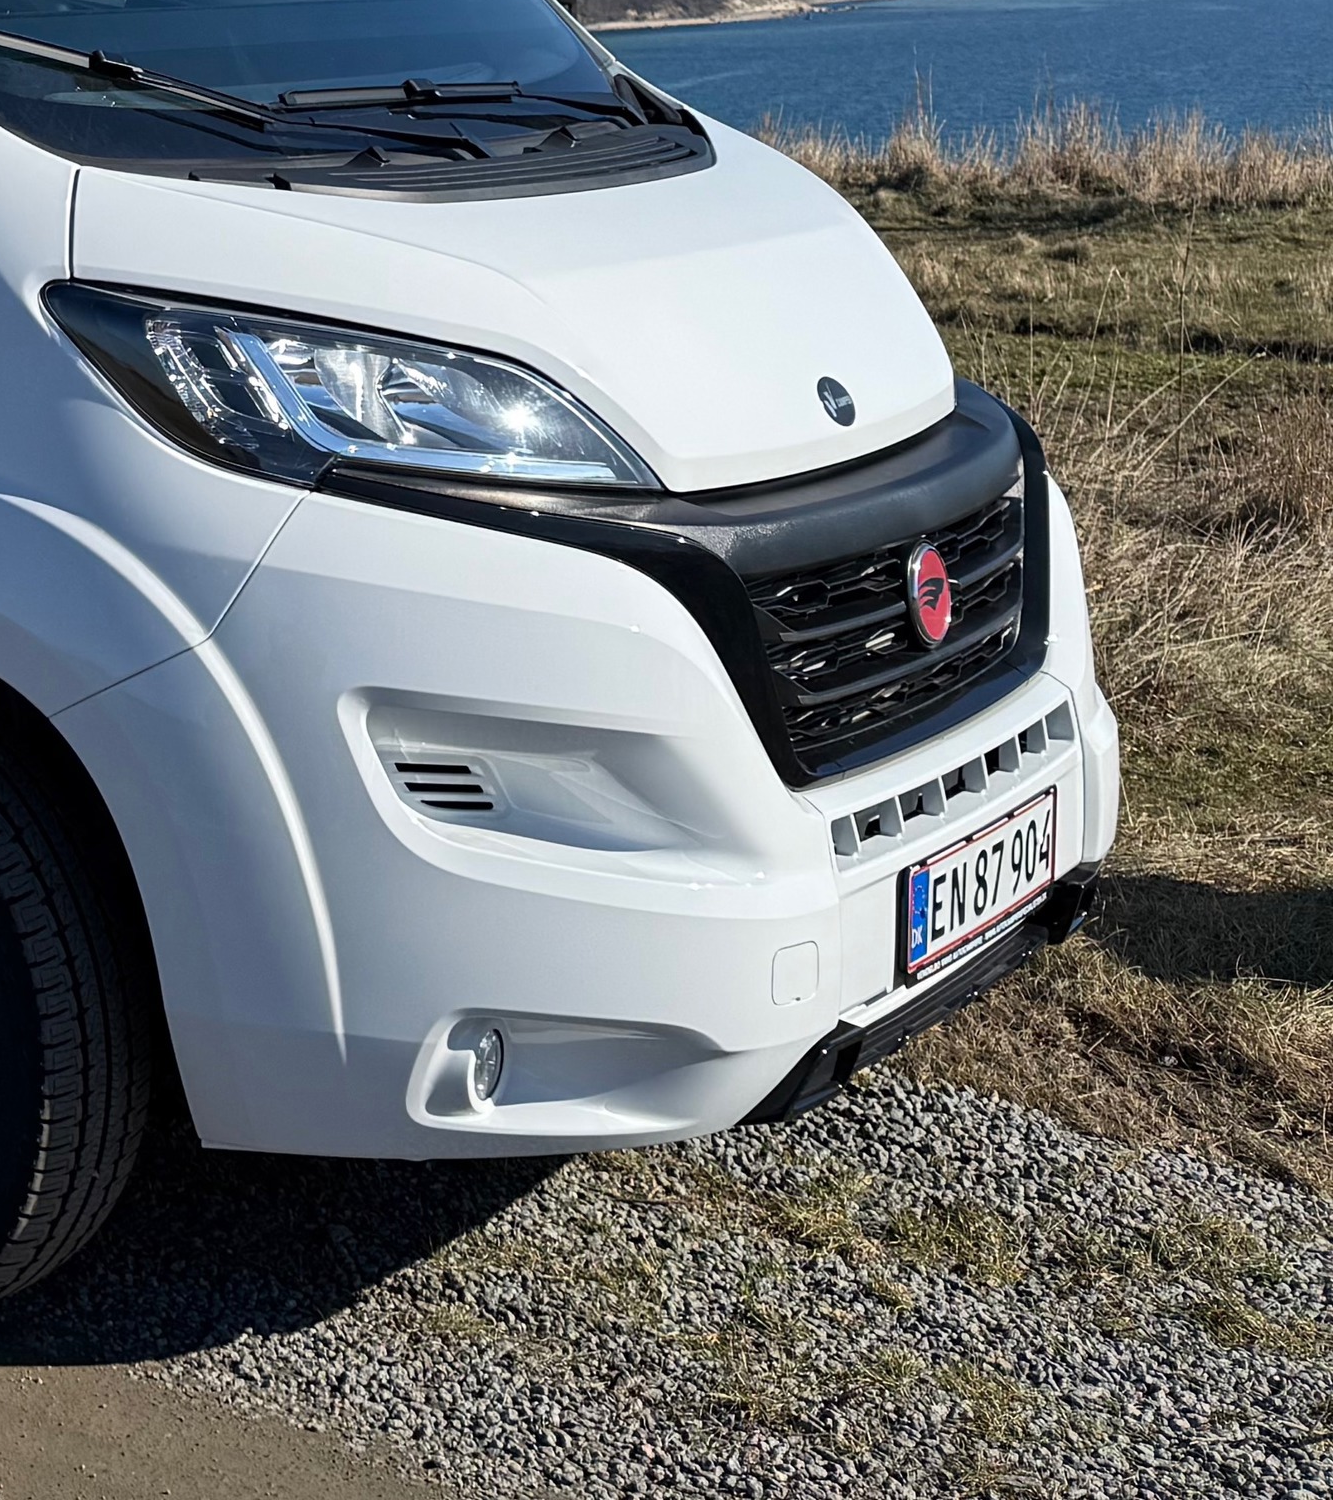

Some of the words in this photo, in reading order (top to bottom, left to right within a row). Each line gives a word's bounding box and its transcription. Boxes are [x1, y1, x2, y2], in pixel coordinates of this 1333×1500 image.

[930, 861, 968, 942] EN
[973, 839, 1005, 917] 87
[1010, 808, 1051, 897] 904
[910, 924, 924, 949] DK
